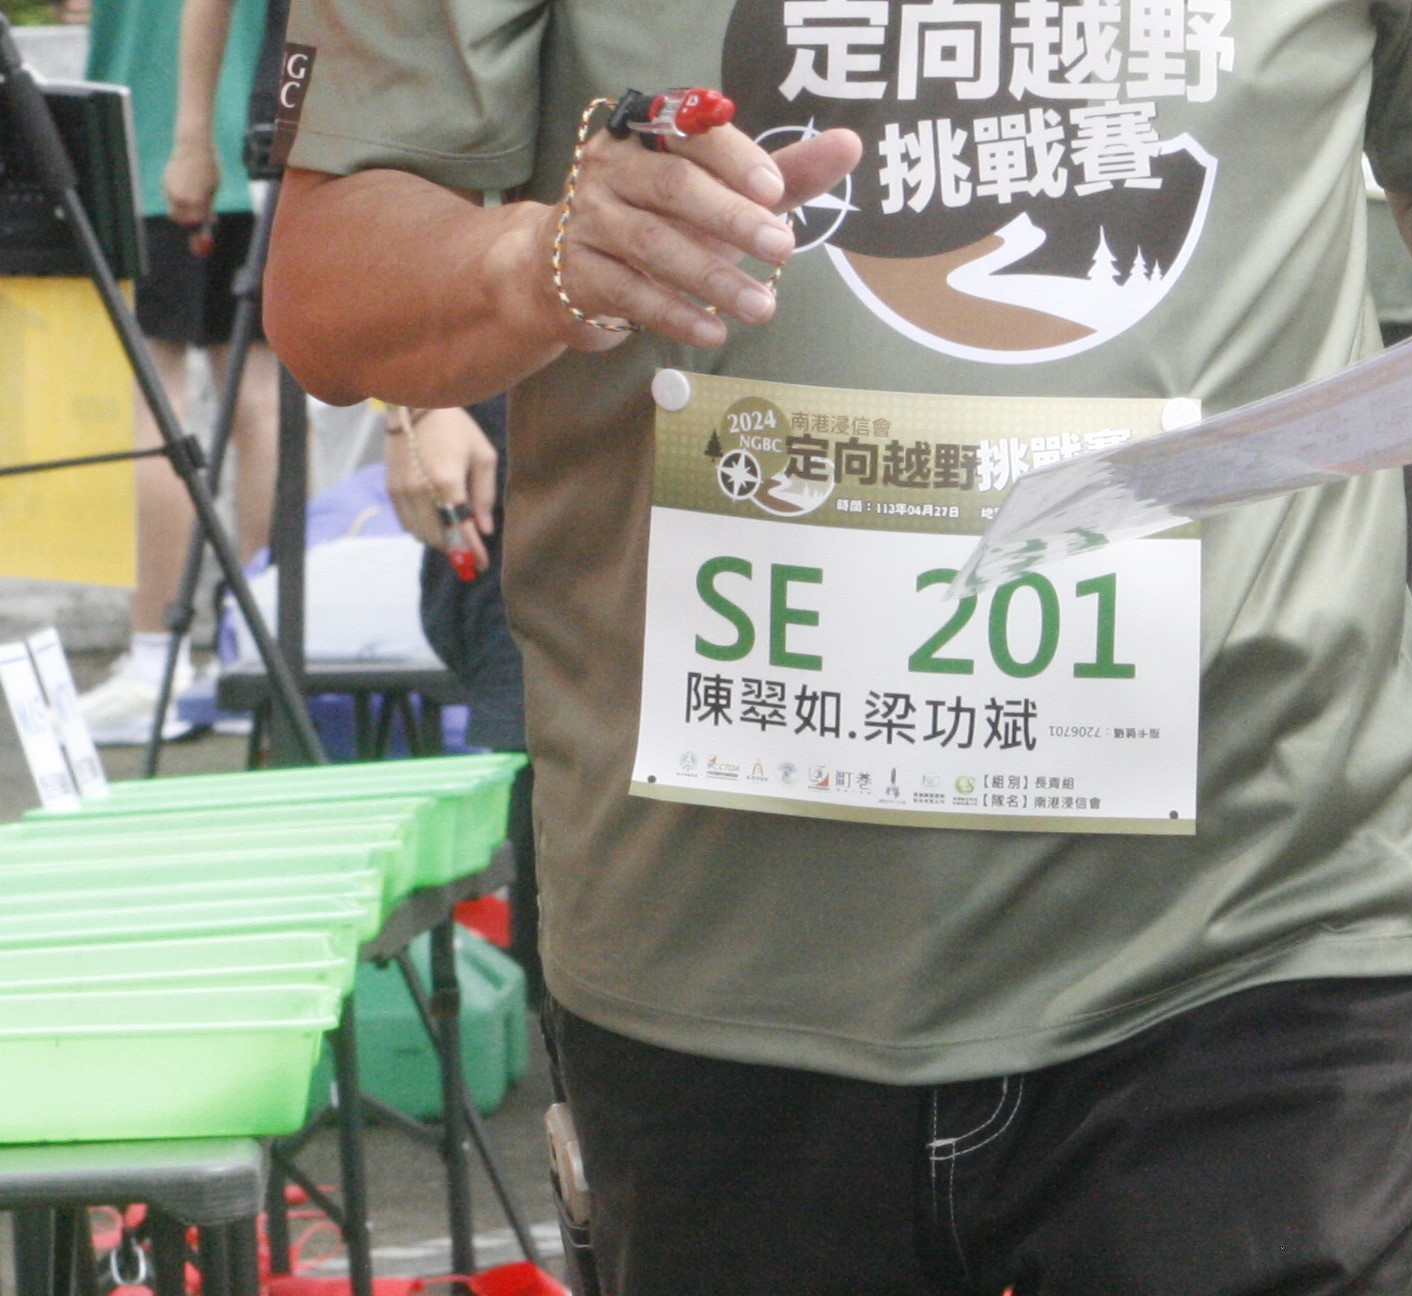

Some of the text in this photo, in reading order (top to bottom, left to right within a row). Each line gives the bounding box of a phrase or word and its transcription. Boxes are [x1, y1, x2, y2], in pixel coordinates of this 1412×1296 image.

[282, 52, 309, 80] G
[280, 81, 301, 109] C
[879, 100, 1163, 215] 挑戰賽
[726, 409, 778, 434] 2024
[791, 412, 893, 438] 南港浸信會
[739, 435, 784, 453] NGBC
[694, 555, 1136, 680] SE 201
[684, 671, 1038, 752] 陳翠如.梁功斌
